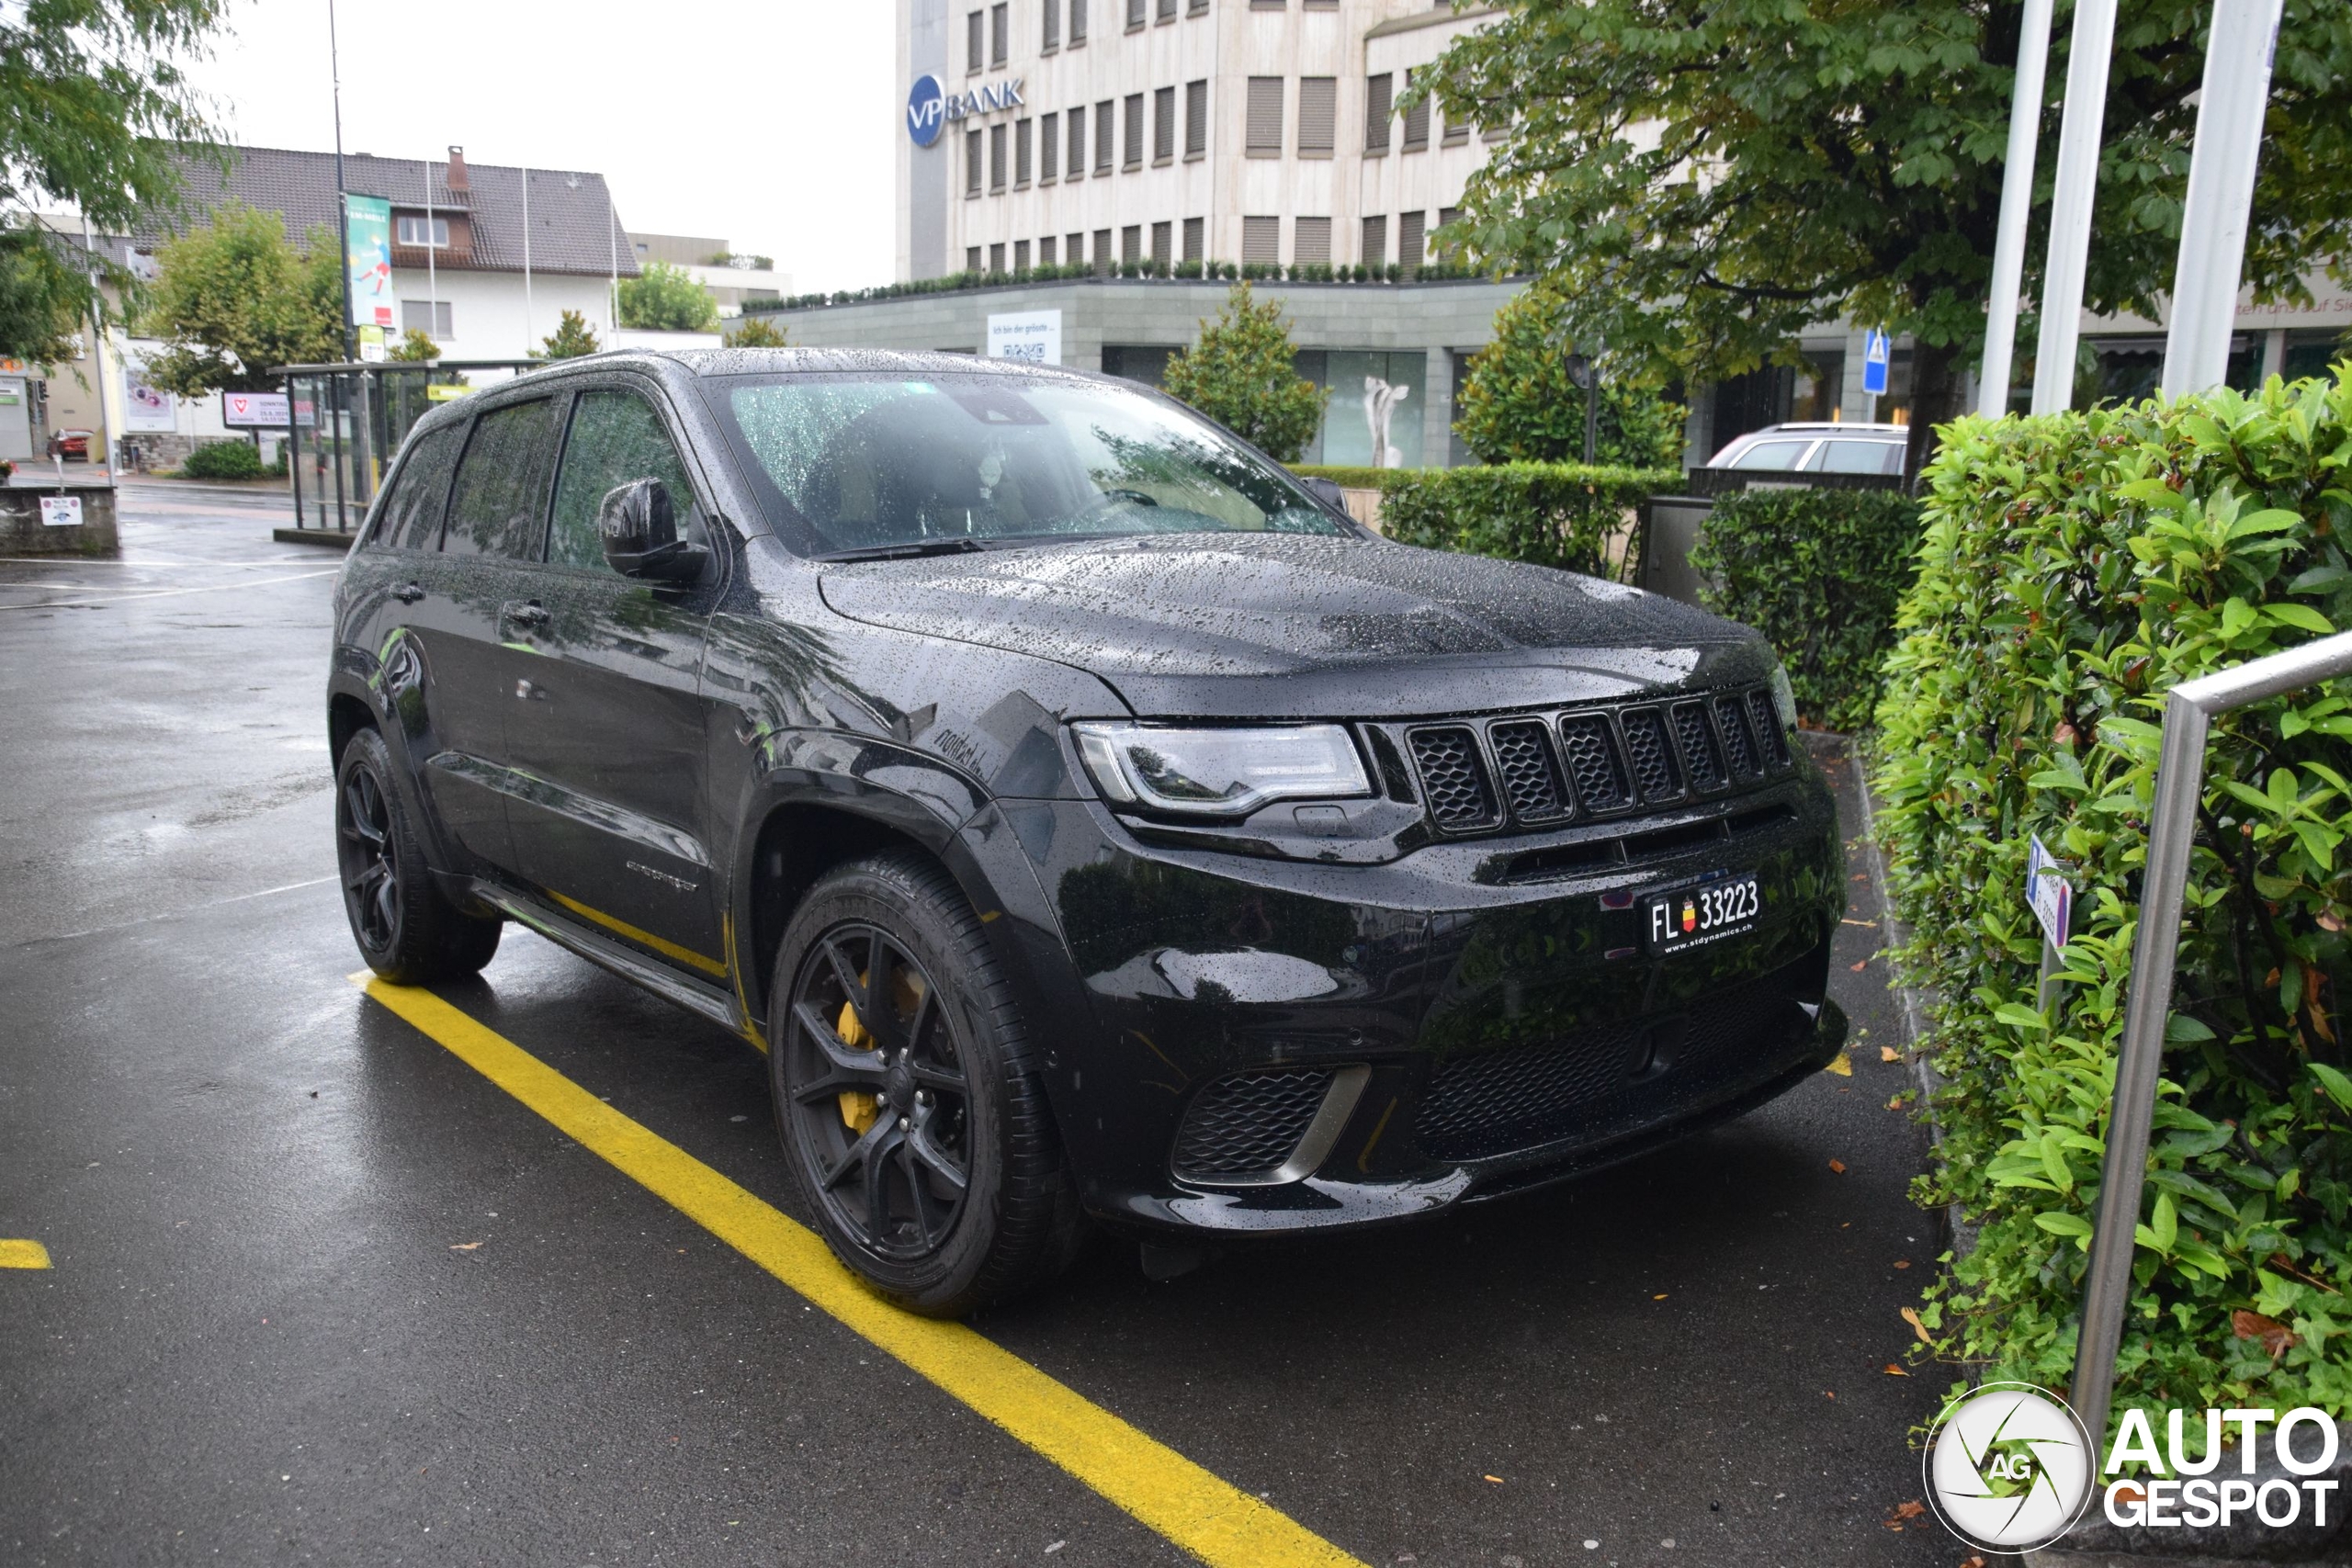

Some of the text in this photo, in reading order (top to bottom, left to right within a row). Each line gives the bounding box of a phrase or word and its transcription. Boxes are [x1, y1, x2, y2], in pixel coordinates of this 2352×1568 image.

[908, 78, 1024, 130] VP BANK
[993, 326, 1001, 334] Ich
[1003, 325, 1012, 334] bin
[1014, 324, 1024, 333] der
[1652, 880, 1759, 942] FL 33223
[1664, 922, 1753, 954] www.stdynamics.ch
